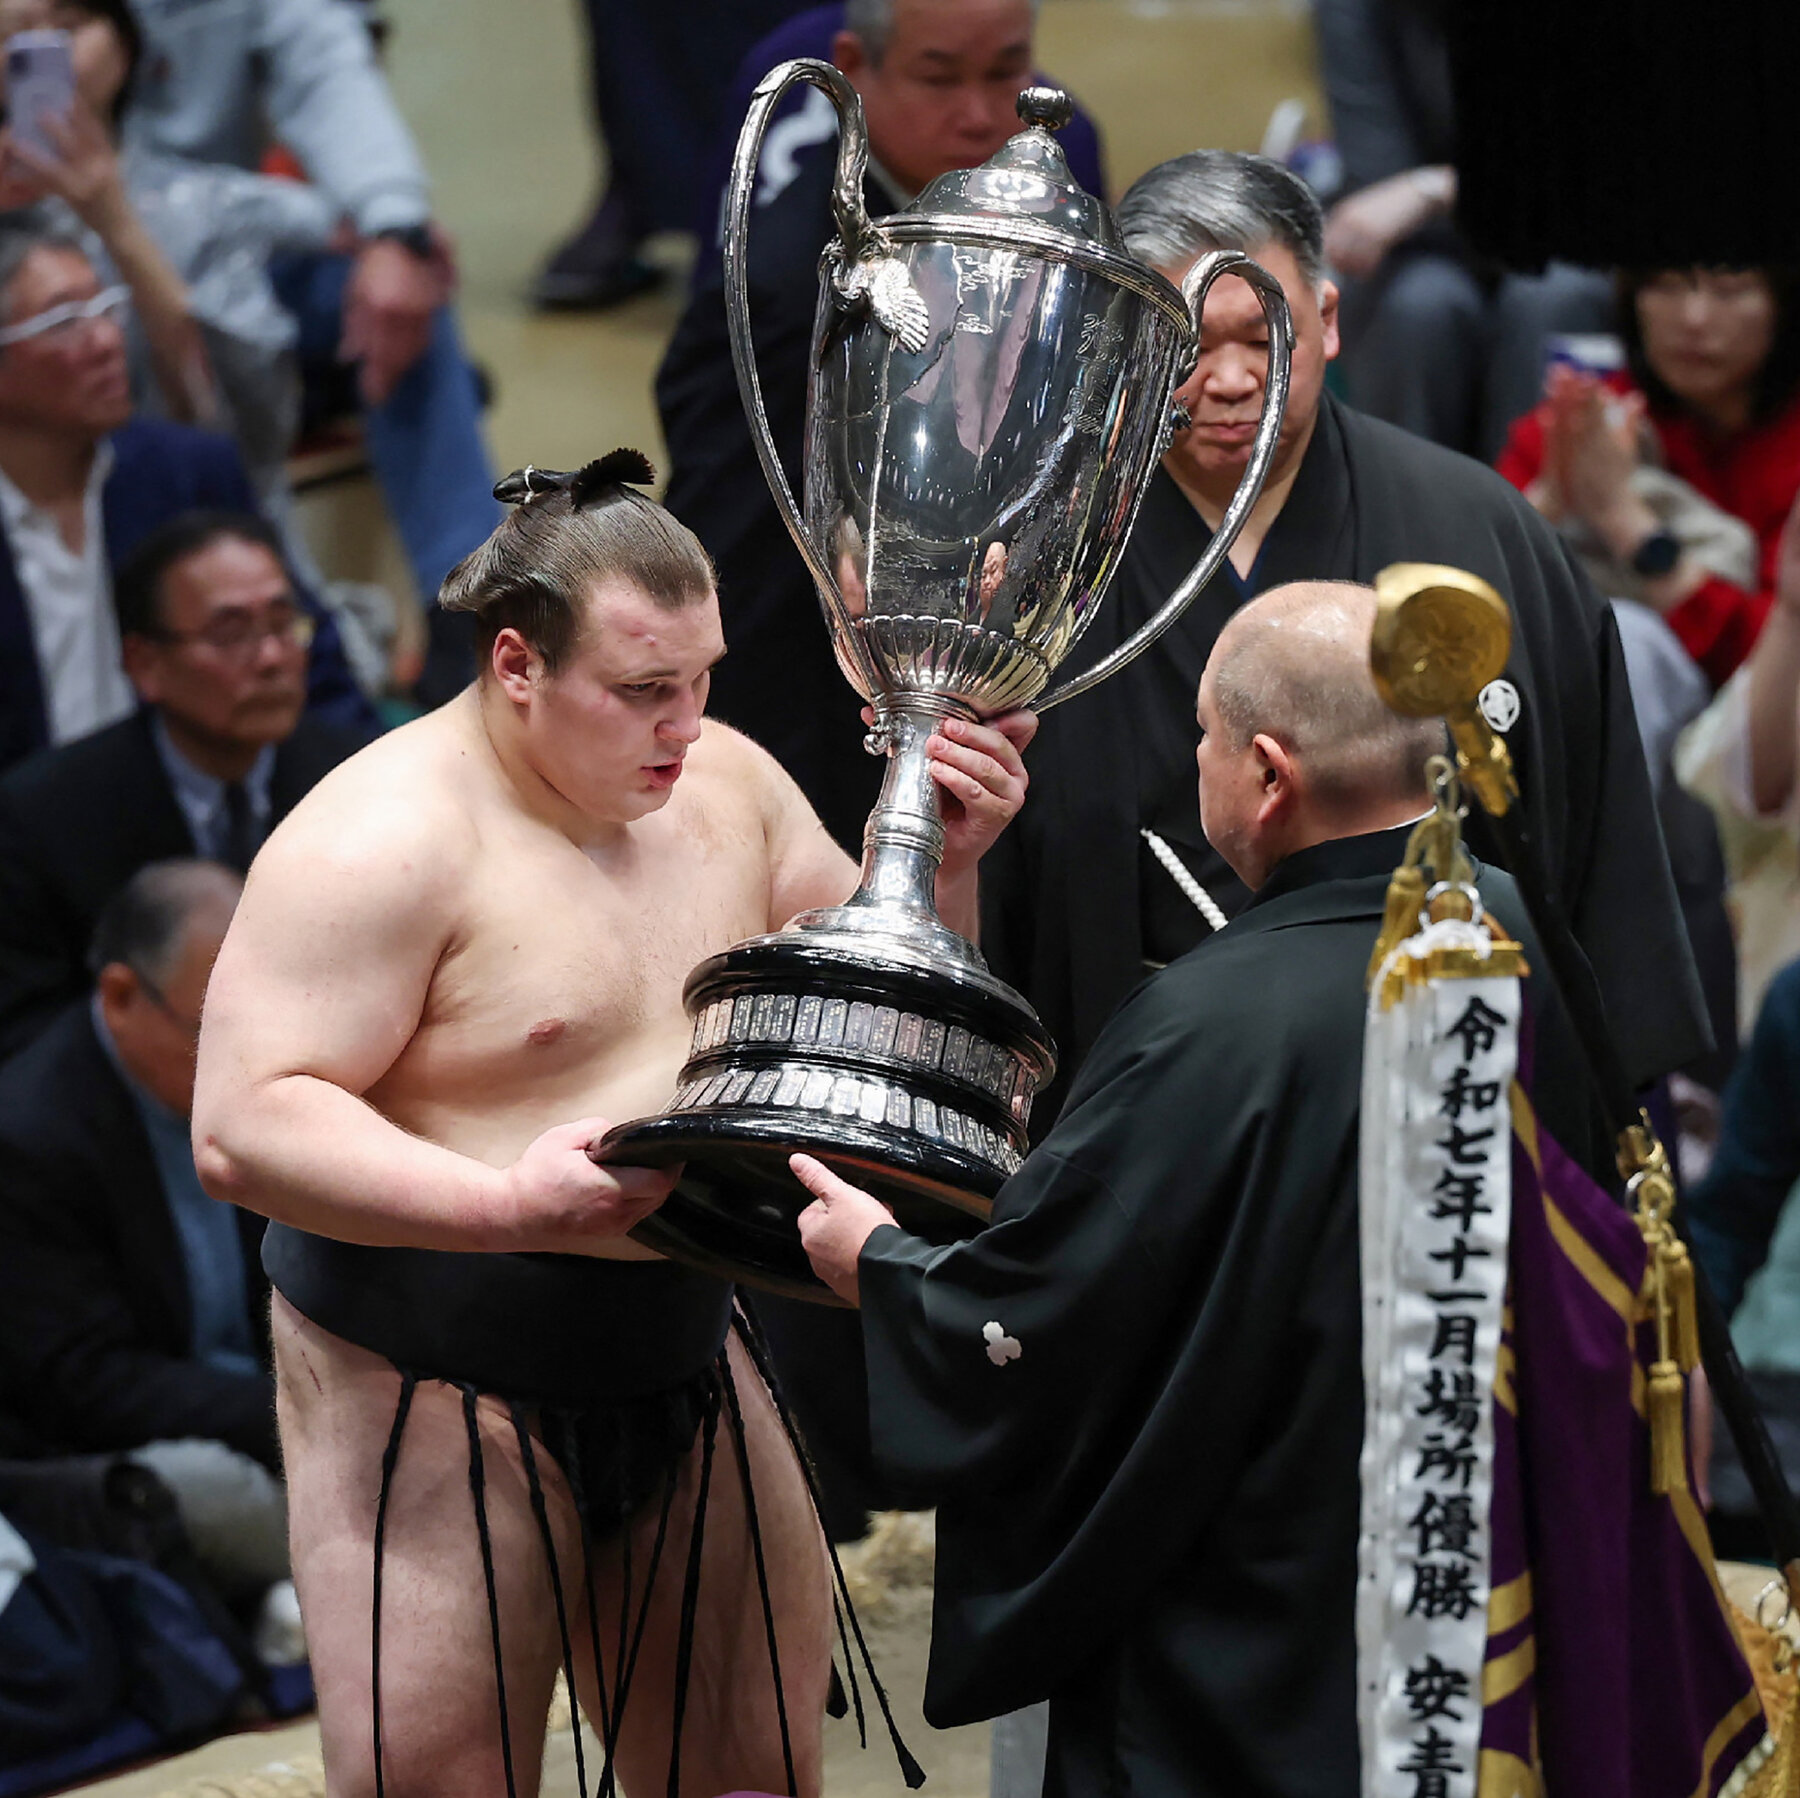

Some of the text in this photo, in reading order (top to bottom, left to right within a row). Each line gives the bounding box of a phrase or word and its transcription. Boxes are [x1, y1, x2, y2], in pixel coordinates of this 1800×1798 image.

[1404, 995, 1508, 1622] 令和七年十一月場所優勝
